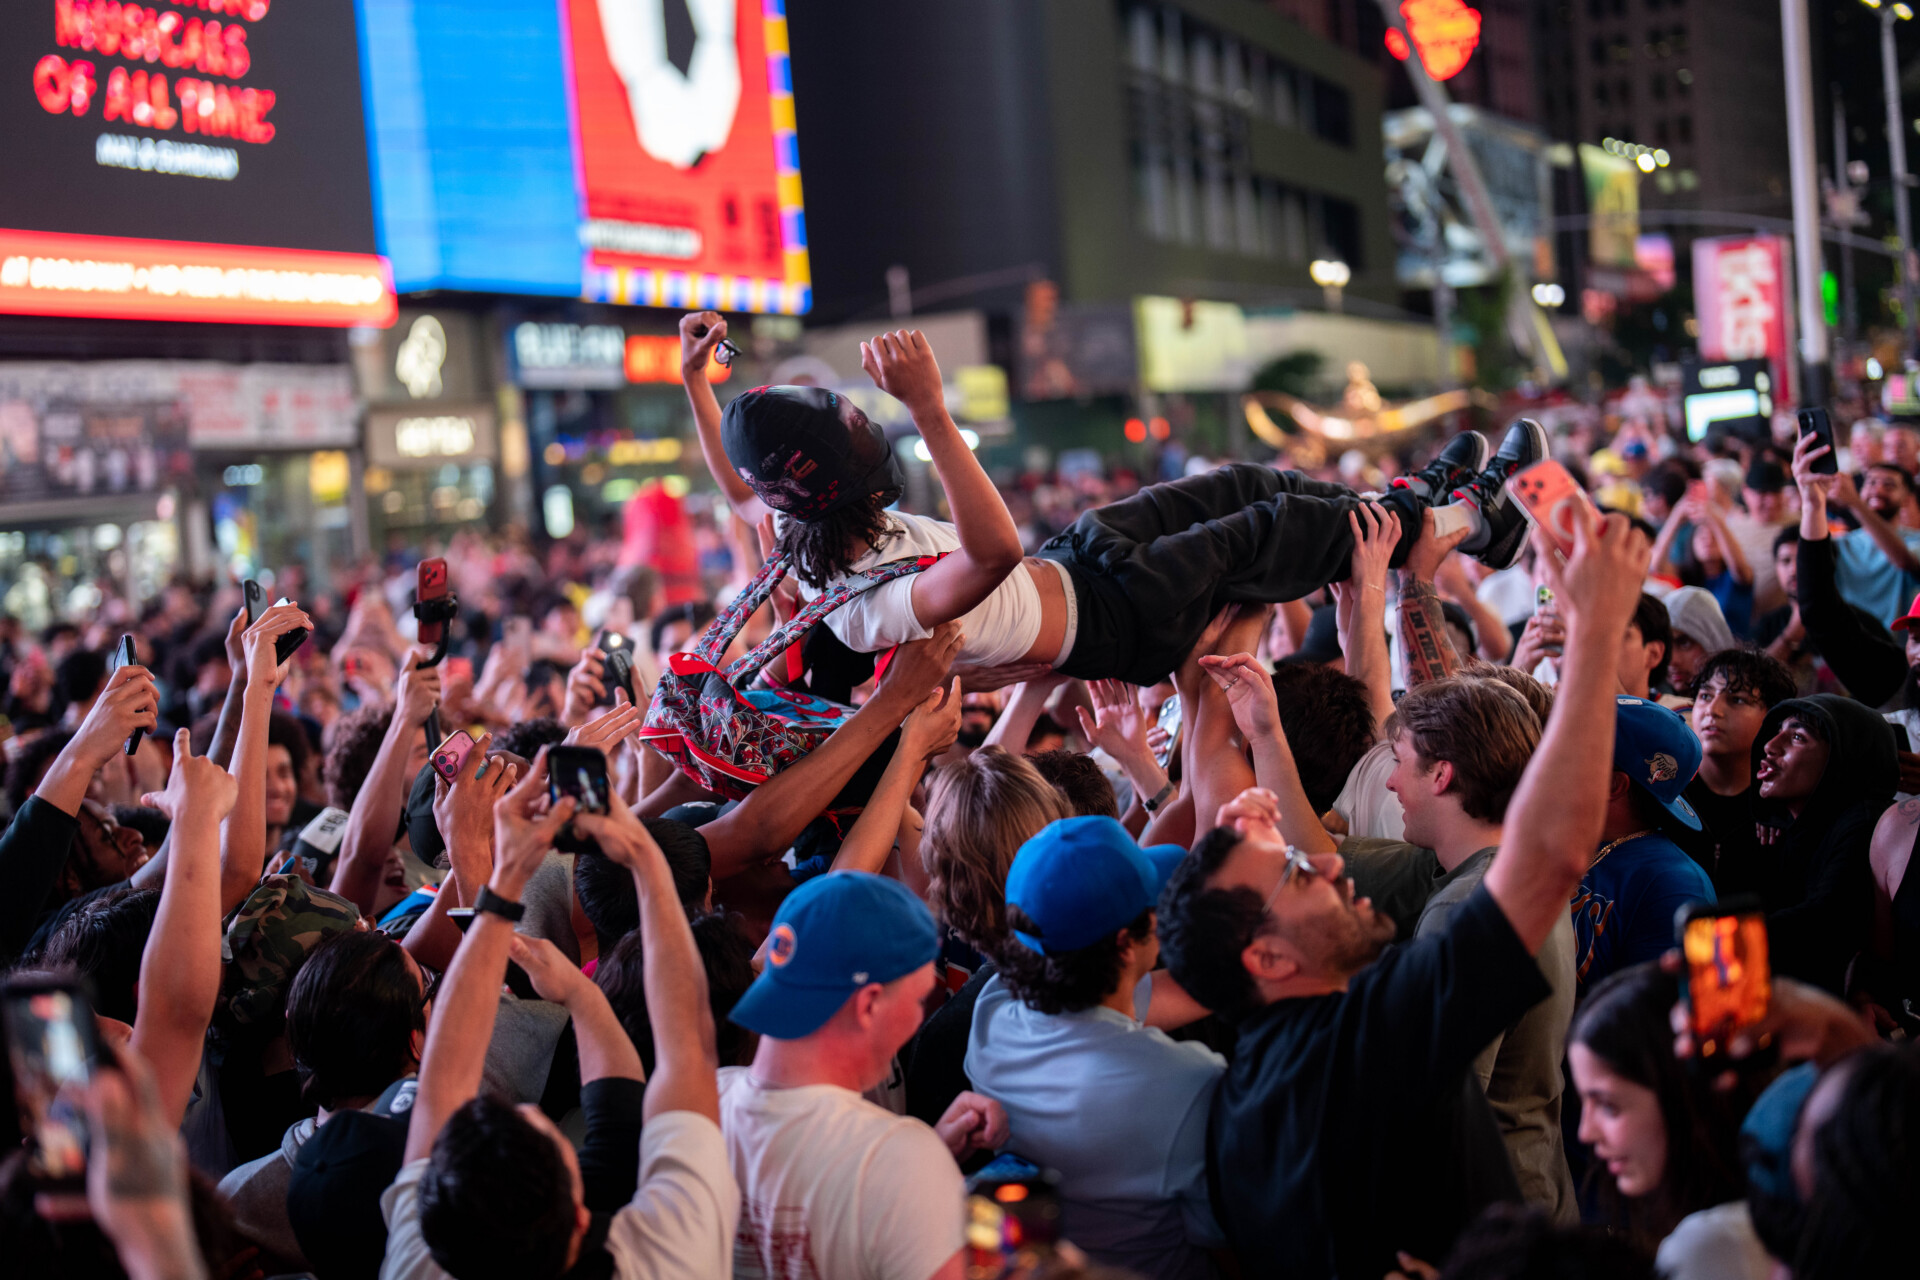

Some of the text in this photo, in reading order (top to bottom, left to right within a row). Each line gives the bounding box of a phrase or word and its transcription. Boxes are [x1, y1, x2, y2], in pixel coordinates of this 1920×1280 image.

[33, 54, 277, 144] OF ALL TIME
